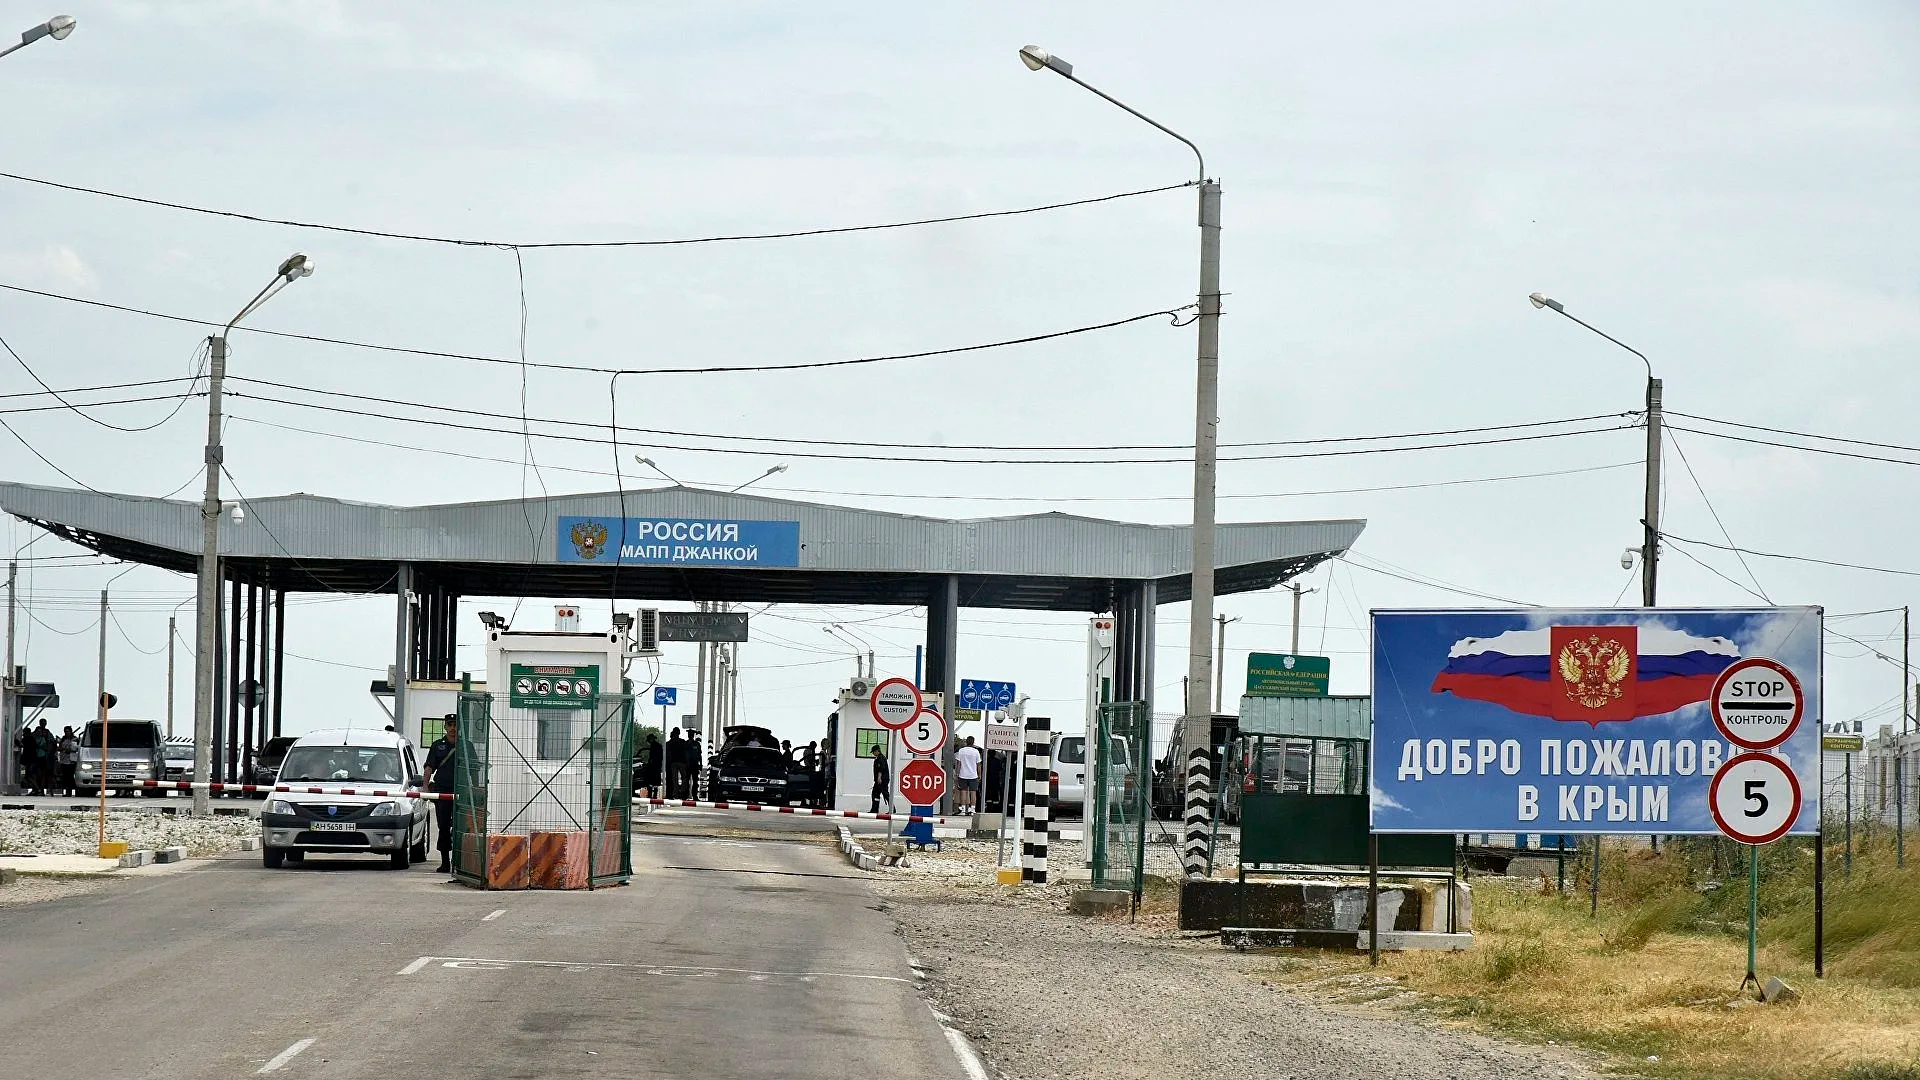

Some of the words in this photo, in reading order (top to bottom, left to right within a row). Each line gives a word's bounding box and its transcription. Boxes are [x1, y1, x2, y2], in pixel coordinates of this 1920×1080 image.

[639, 522, 738, 542] РОССИЯ
[620, 545, 668, 558] МАПП
[673, 545, 758, 561] ДЖАНКОЙ
[1731, 681, 1784, 697] STOP
[1727, 715, 1788, 724] КОНТРОЛЬ
[918, 723, 929, 740] 5
[1398, 739, 1521, 780] ДОБРО
[1540, 739, 1791, 775] ПОЖАЛОВ
[902, 774, 943, 789] STOP
[1518, 785, 1539, 821] В
[1559, 785, 1669, 821] КРЫМ
[1744, 781, 1769, 817] 5
